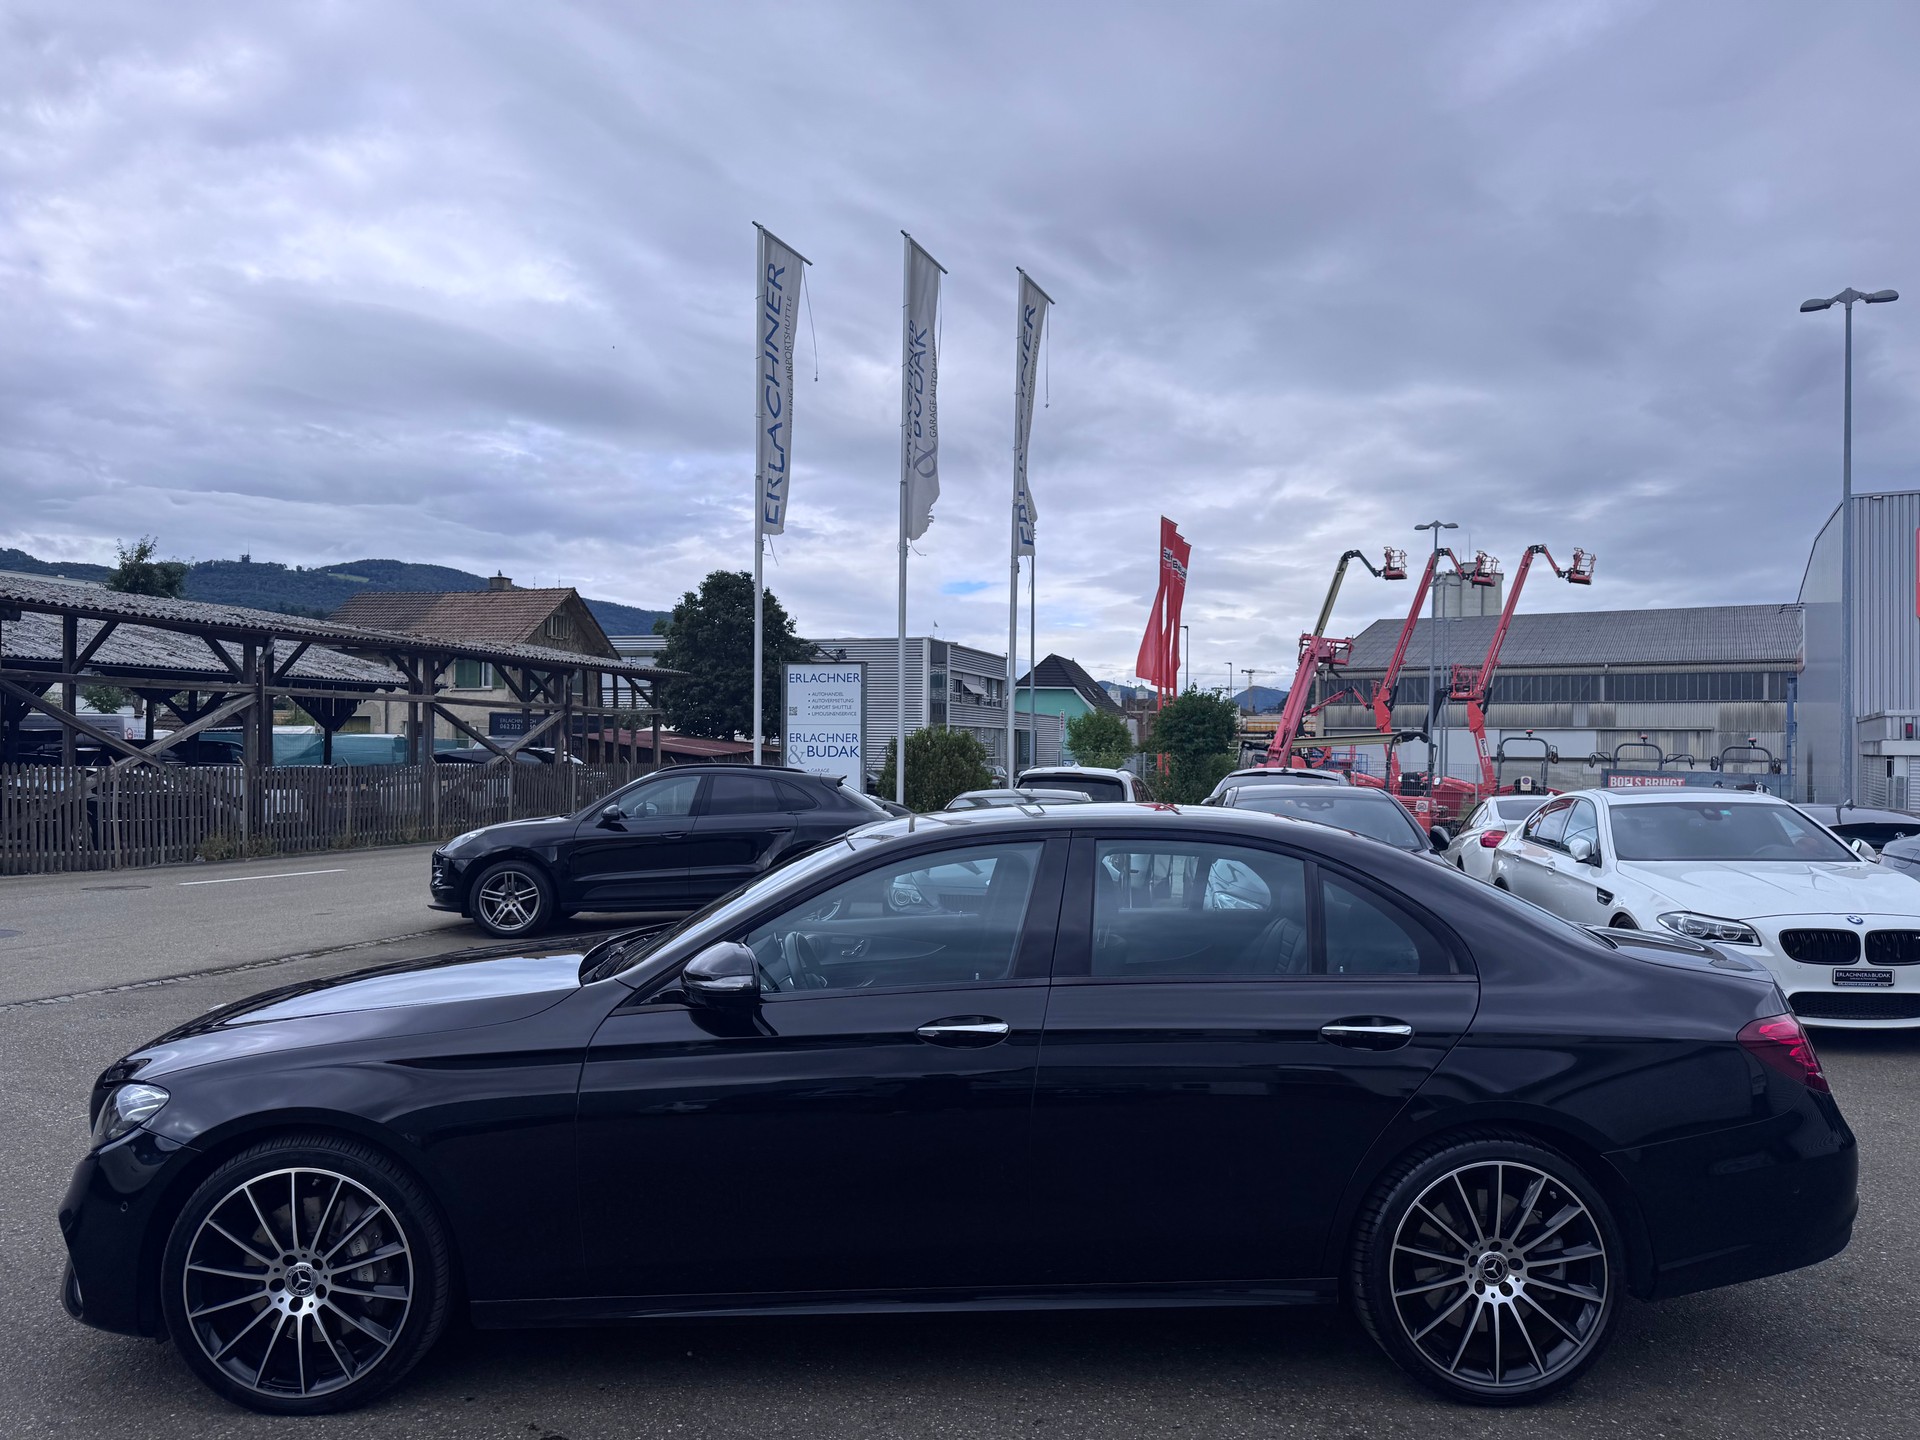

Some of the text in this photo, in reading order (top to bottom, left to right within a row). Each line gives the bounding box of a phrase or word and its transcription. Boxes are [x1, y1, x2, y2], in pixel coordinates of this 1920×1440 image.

[784, 295, 793, 380] AIRPORTSHUTTLE
[764, 263, 786, 525] ERLACHNER
[929, 401, 938, 438] GARAGE
[913, 440, 937, 479] &
[789, 673, 860, 683] ERLACHNER
[789, 733, 859, 743] ERLACHNER
[787, 744, 860, 765] & BUDAK
[1610, 776, 1642, 787] BOELS
